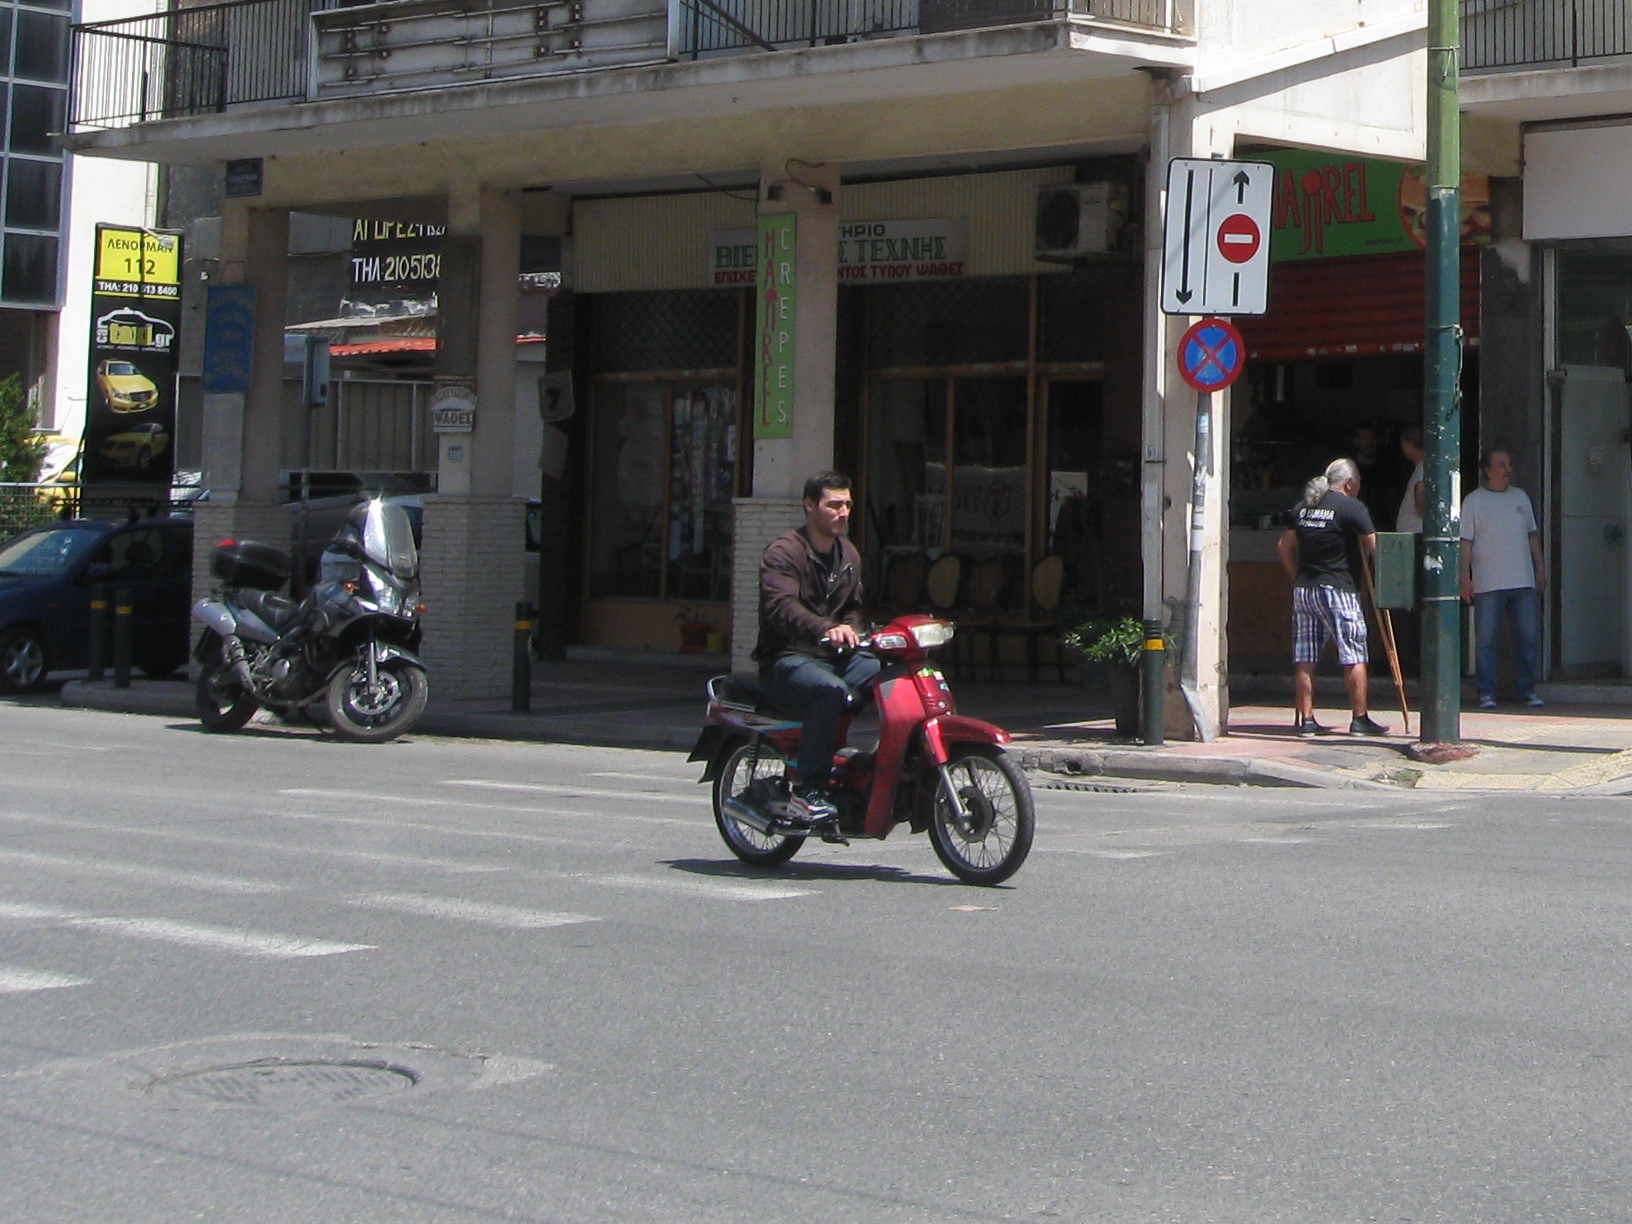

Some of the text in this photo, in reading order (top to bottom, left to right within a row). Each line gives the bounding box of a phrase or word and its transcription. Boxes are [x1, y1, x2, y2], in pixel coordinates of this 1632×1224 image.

[840, 223, 886, 239] ΗΡΙΟ
[107, 238, 174, 253] ΛΕΝΟΜΑΝ
[716, 245, 758, 268] ΒΙΕ
[855, 236, 948, 263] ΤΕΧΝΗΣ
[124, 257, 156, 275] 112
[714, 269, 758, 285] ΕΠΙΣΚΕ
[870, 261, 913, 279] ΤΥΠΟΥ
[915, 261, 965, 277] ΨΑΘΕΣ
